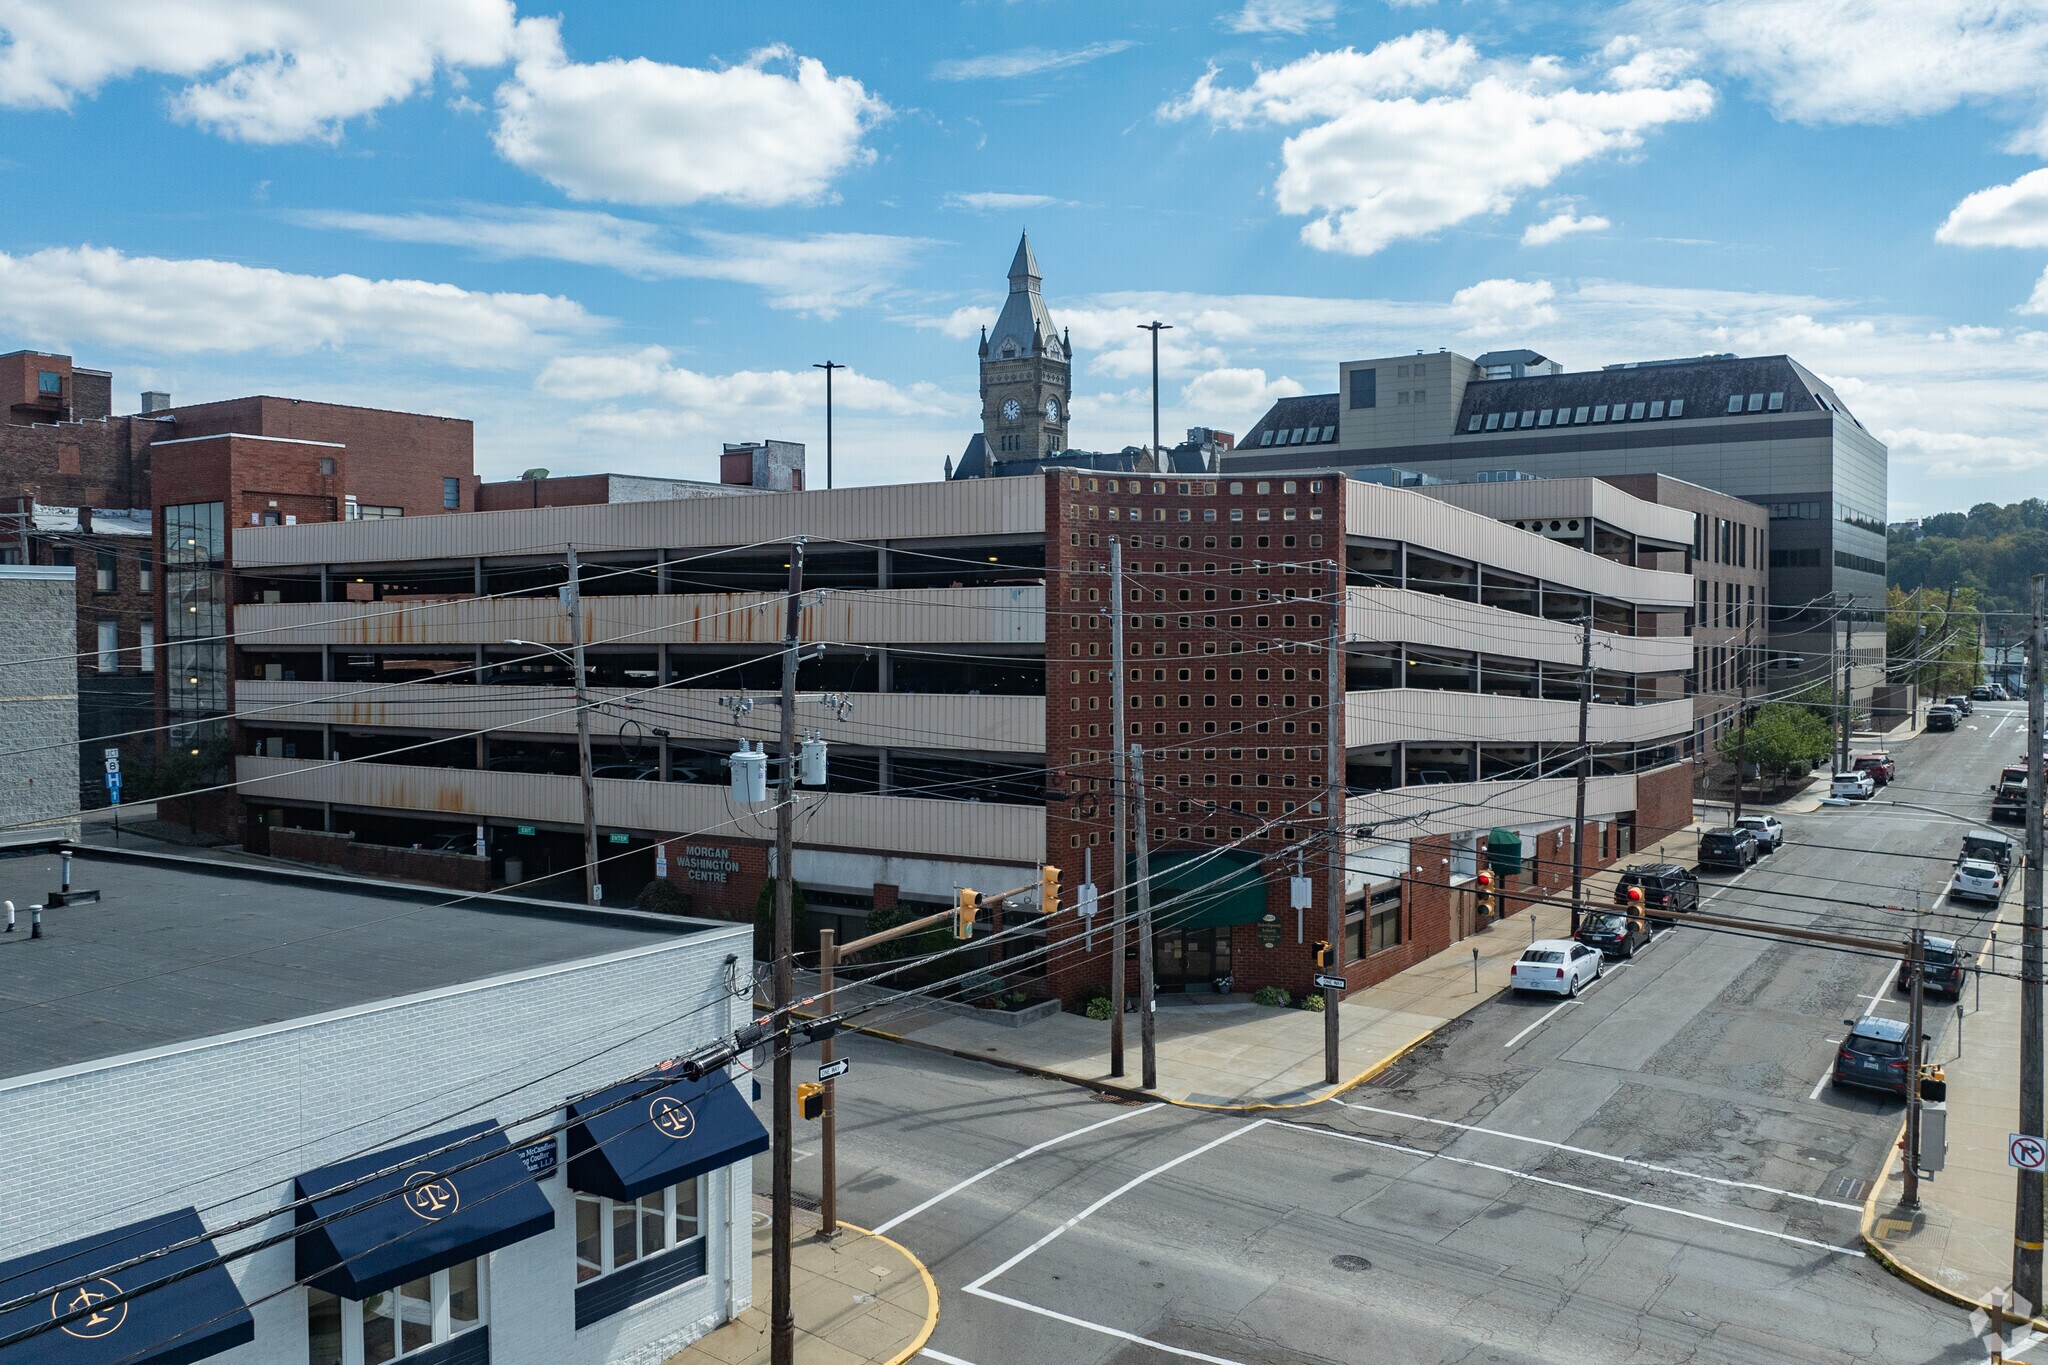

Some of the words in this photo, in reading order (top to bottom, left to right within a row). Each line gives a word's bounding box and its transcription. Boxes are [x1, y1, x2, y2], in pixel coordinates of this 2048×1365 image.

[110, 762, 116, 770] 8
[108, 774, 120, 787] H
[686, 846, 728, 859] MORGAN
[676, 856, 740, 872] WASHINGTON
[688, 870, 727, 883] CENTRE
[822, 1068, 830, 1076] ONE
[526, 1142, 556, 1156] McCandless
[530, 1152, 550, 1162] Coulter
